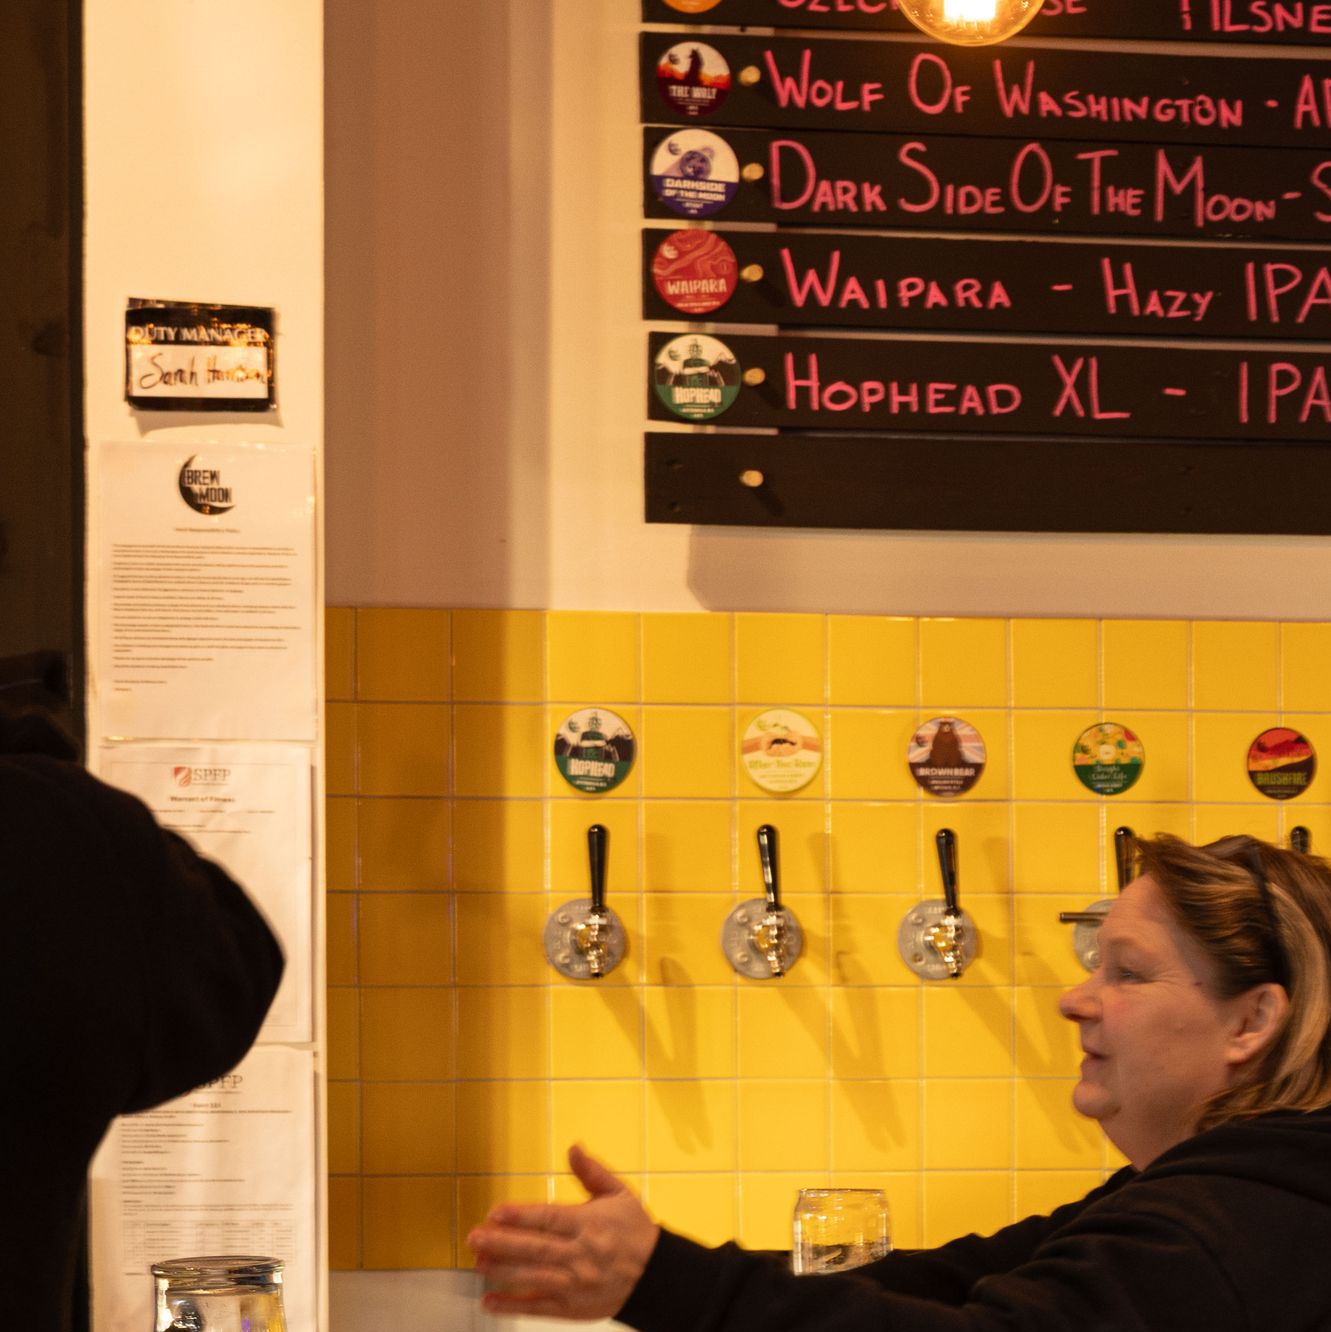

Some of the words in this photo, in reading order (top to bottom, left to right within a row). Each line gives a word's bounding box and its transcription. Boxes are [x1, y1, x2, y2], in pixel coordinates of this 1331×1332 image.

[665, 278, 728, 295] WAIPARA
[671, 386, 722, 405] HOPHEAD
[1052, 354, 1131, 420] XL
[184, 469, 220, 486] BREW
[200, 1074, 244, 1090] PFP
